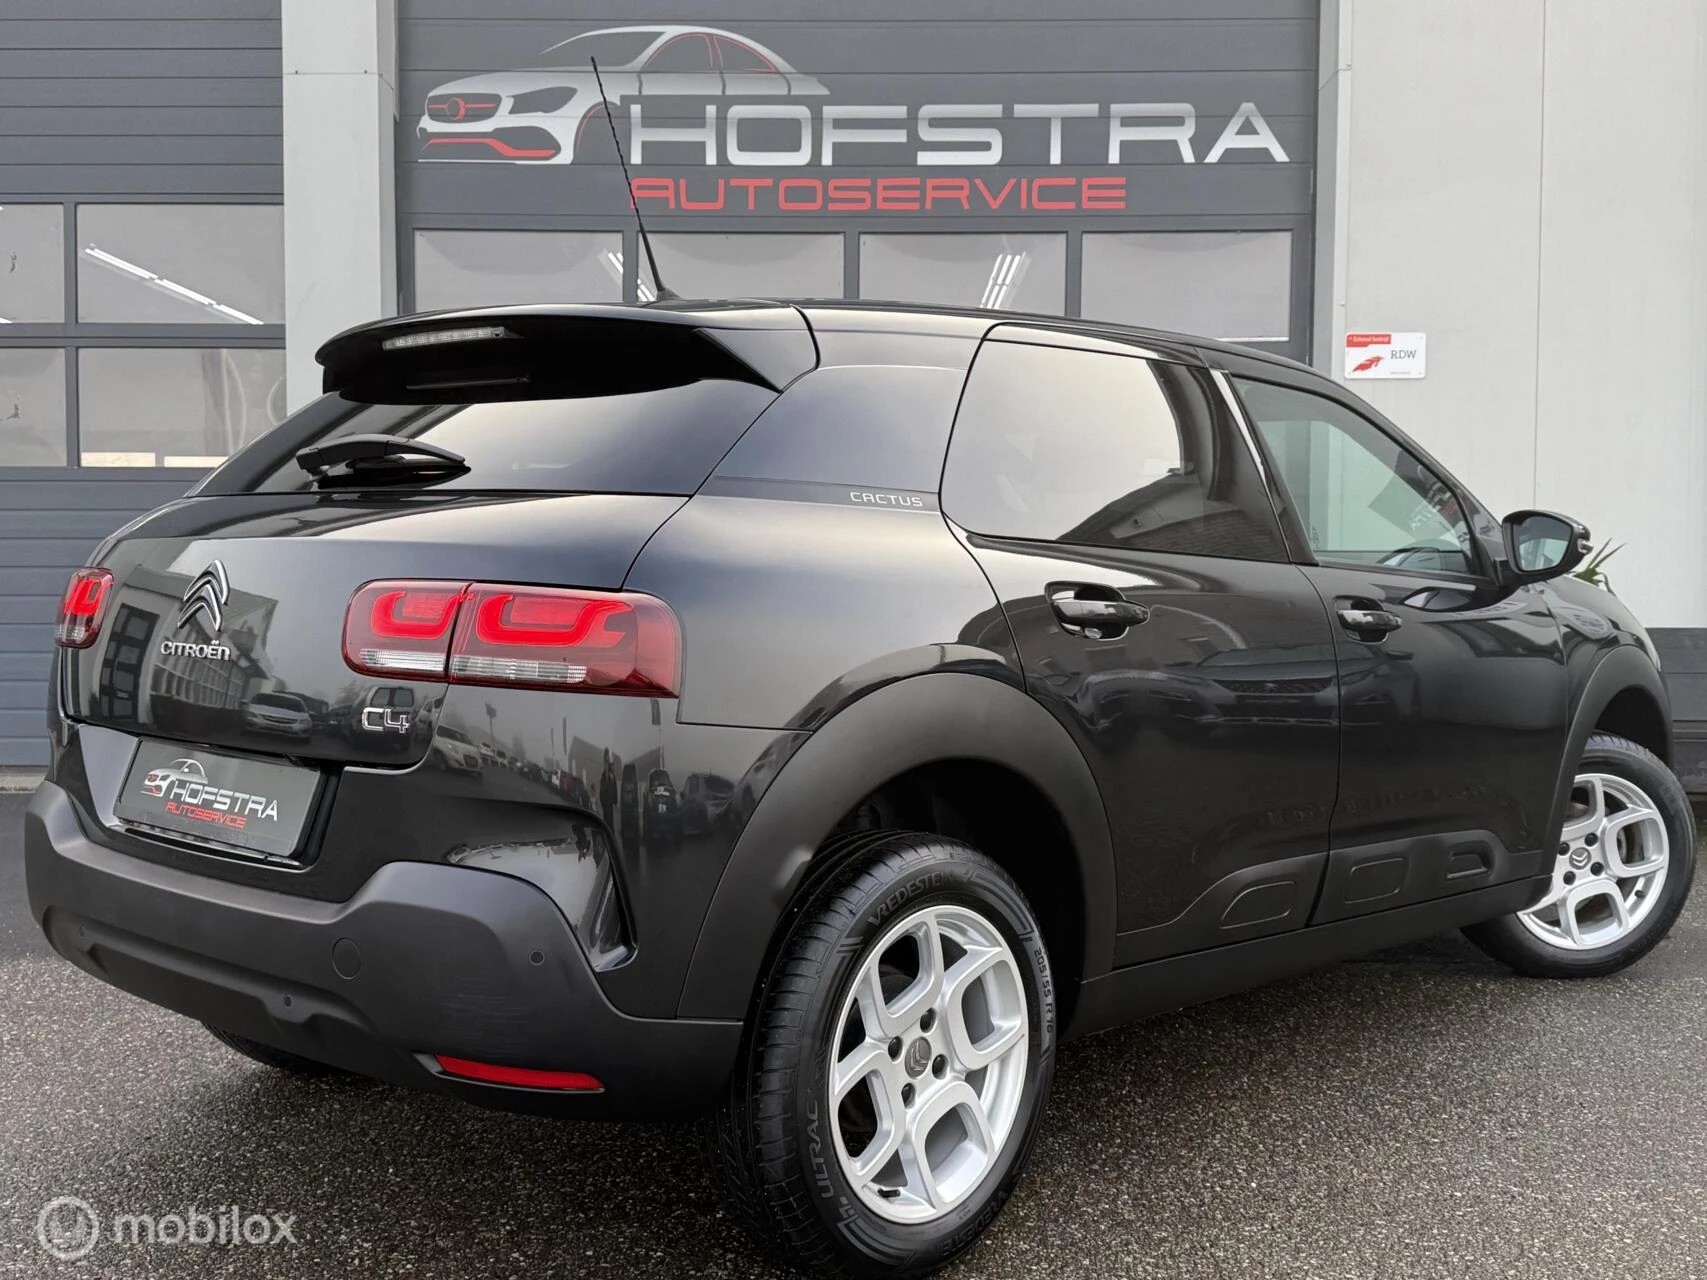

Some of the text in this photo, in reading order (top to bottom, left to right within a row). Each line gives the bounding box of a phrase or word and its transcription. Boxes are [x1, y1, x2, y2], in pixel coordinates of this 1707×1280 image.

[630, 102, 1290, 166] HOFSTRA
[630, 177, 1127, 211] AUTOSERVICE
[1391, 350, 1417, 360] RDW
[849, 491, 924, 507] CACTUS
[361, 707, 410, 734] C4
[164, 801, 248, 829] AUTOSERVICE
[169, 780, 278, 822] HOFSTRA
[1033, 948, 1052, 998] 205/55
[805, 1099, 835, 1199] ULTRAC
